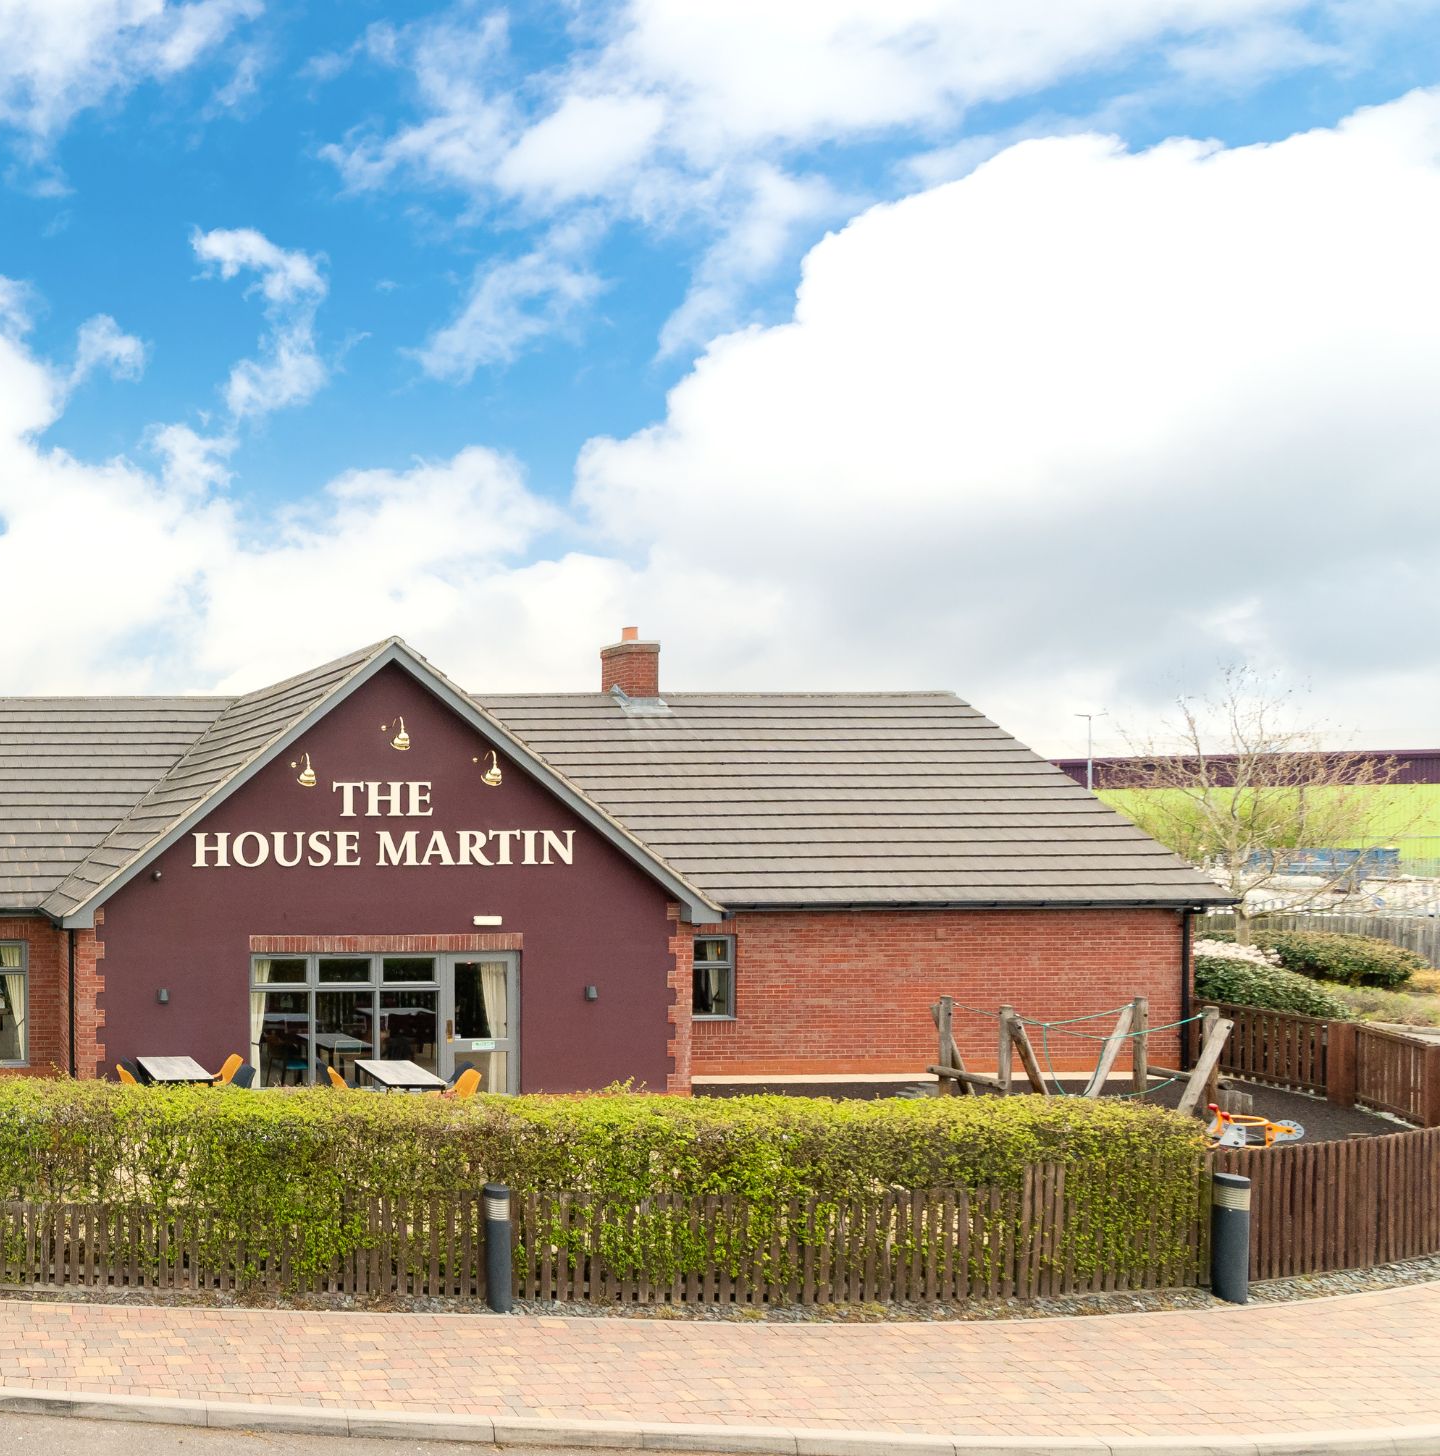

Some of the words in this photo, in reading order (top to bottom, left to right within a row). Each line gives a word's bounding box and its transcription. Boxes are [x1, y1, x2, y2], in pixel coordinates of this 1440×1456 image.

[332, 781, 434, 817] THE
[192, 831, 362, 868] HOUSE
[375, 829, 576, 867] MARTIN
